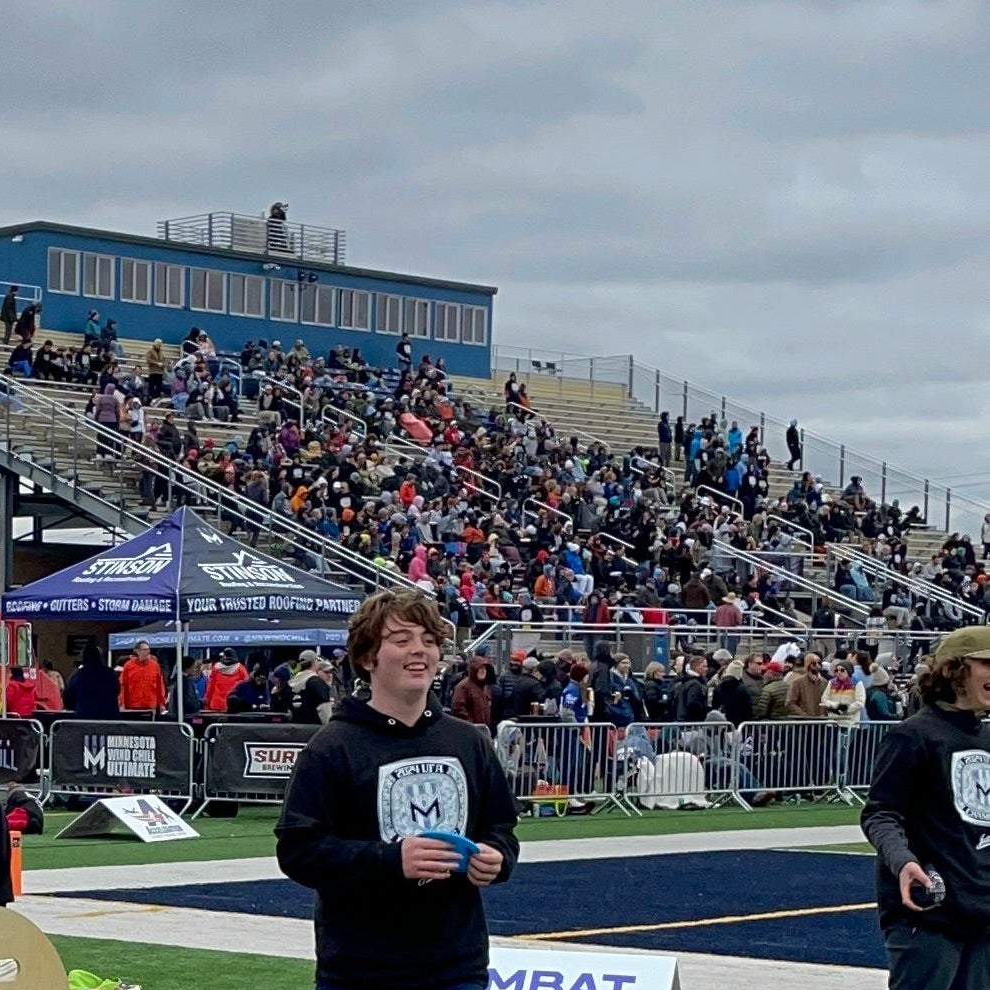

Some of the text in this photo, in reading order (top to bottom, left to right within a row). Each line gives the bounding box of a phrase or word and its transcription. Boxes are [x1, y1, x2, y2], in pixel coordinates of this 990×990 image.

[82, 559, 172, 575] STINSON
[202, 567, 295, 583] STINSON
[50, 599, 89, 611] GUTTERS
[98, 599, 130, 611] STORM
[131, 600, 172, 612] DAMAGE
[187, 596, 361, 613] YOUR TRUSTED ROOFING PARTNER
[107, 735, 156, 749] MINNESOTA
[107, 749, 156, 762] WIND CHILL
[254, 750, 295, 763] SUR
[107, 762, 156, 778] ULTIMATE
[411, 797, 440, 822] M
